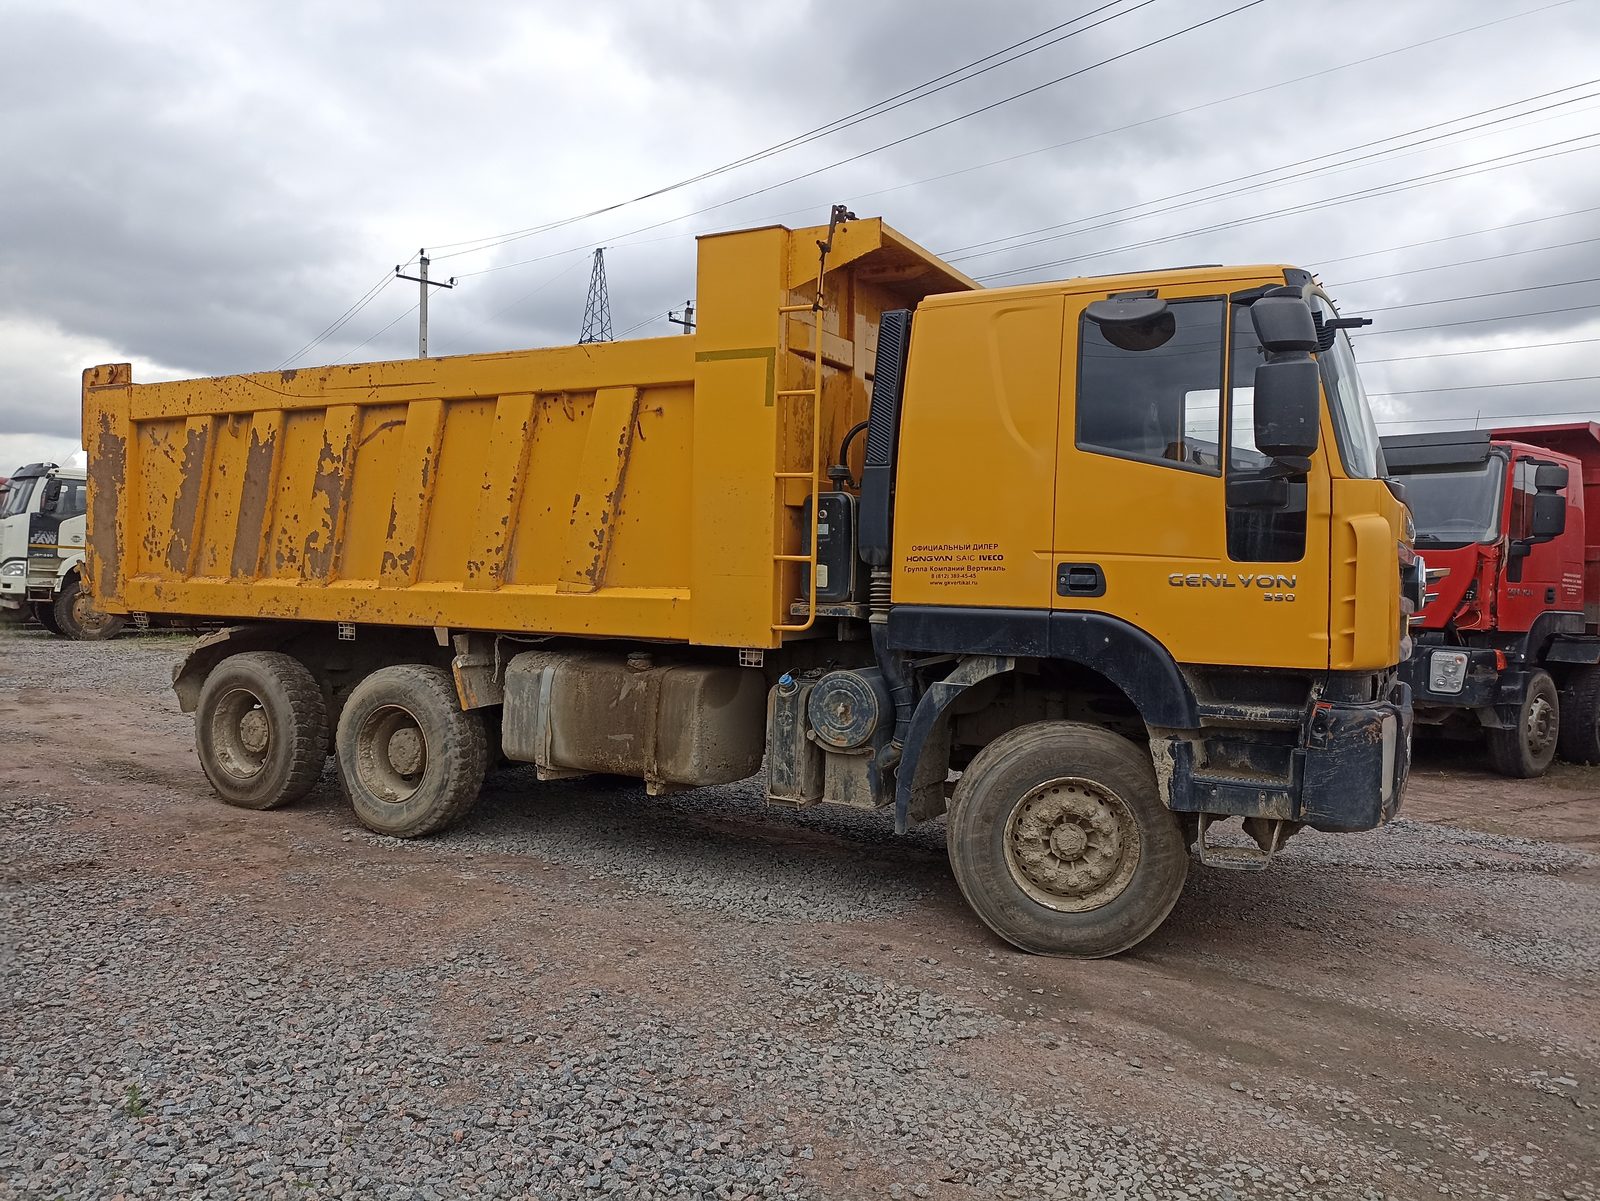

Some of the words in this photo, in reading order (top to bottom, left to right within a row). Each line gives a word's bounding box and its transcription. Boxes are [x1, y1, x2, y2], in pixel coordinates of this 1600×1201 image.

[911, 544, 971, 552] ОФИЦИАЛЬНЫЙ
[972, 543, 999, 551] ДИЛЕР
[956, 554, 975, 562] SAIC
[1168, 573, 1297, 589] GENLYON
[1263, 592, 1296, 602] 350
